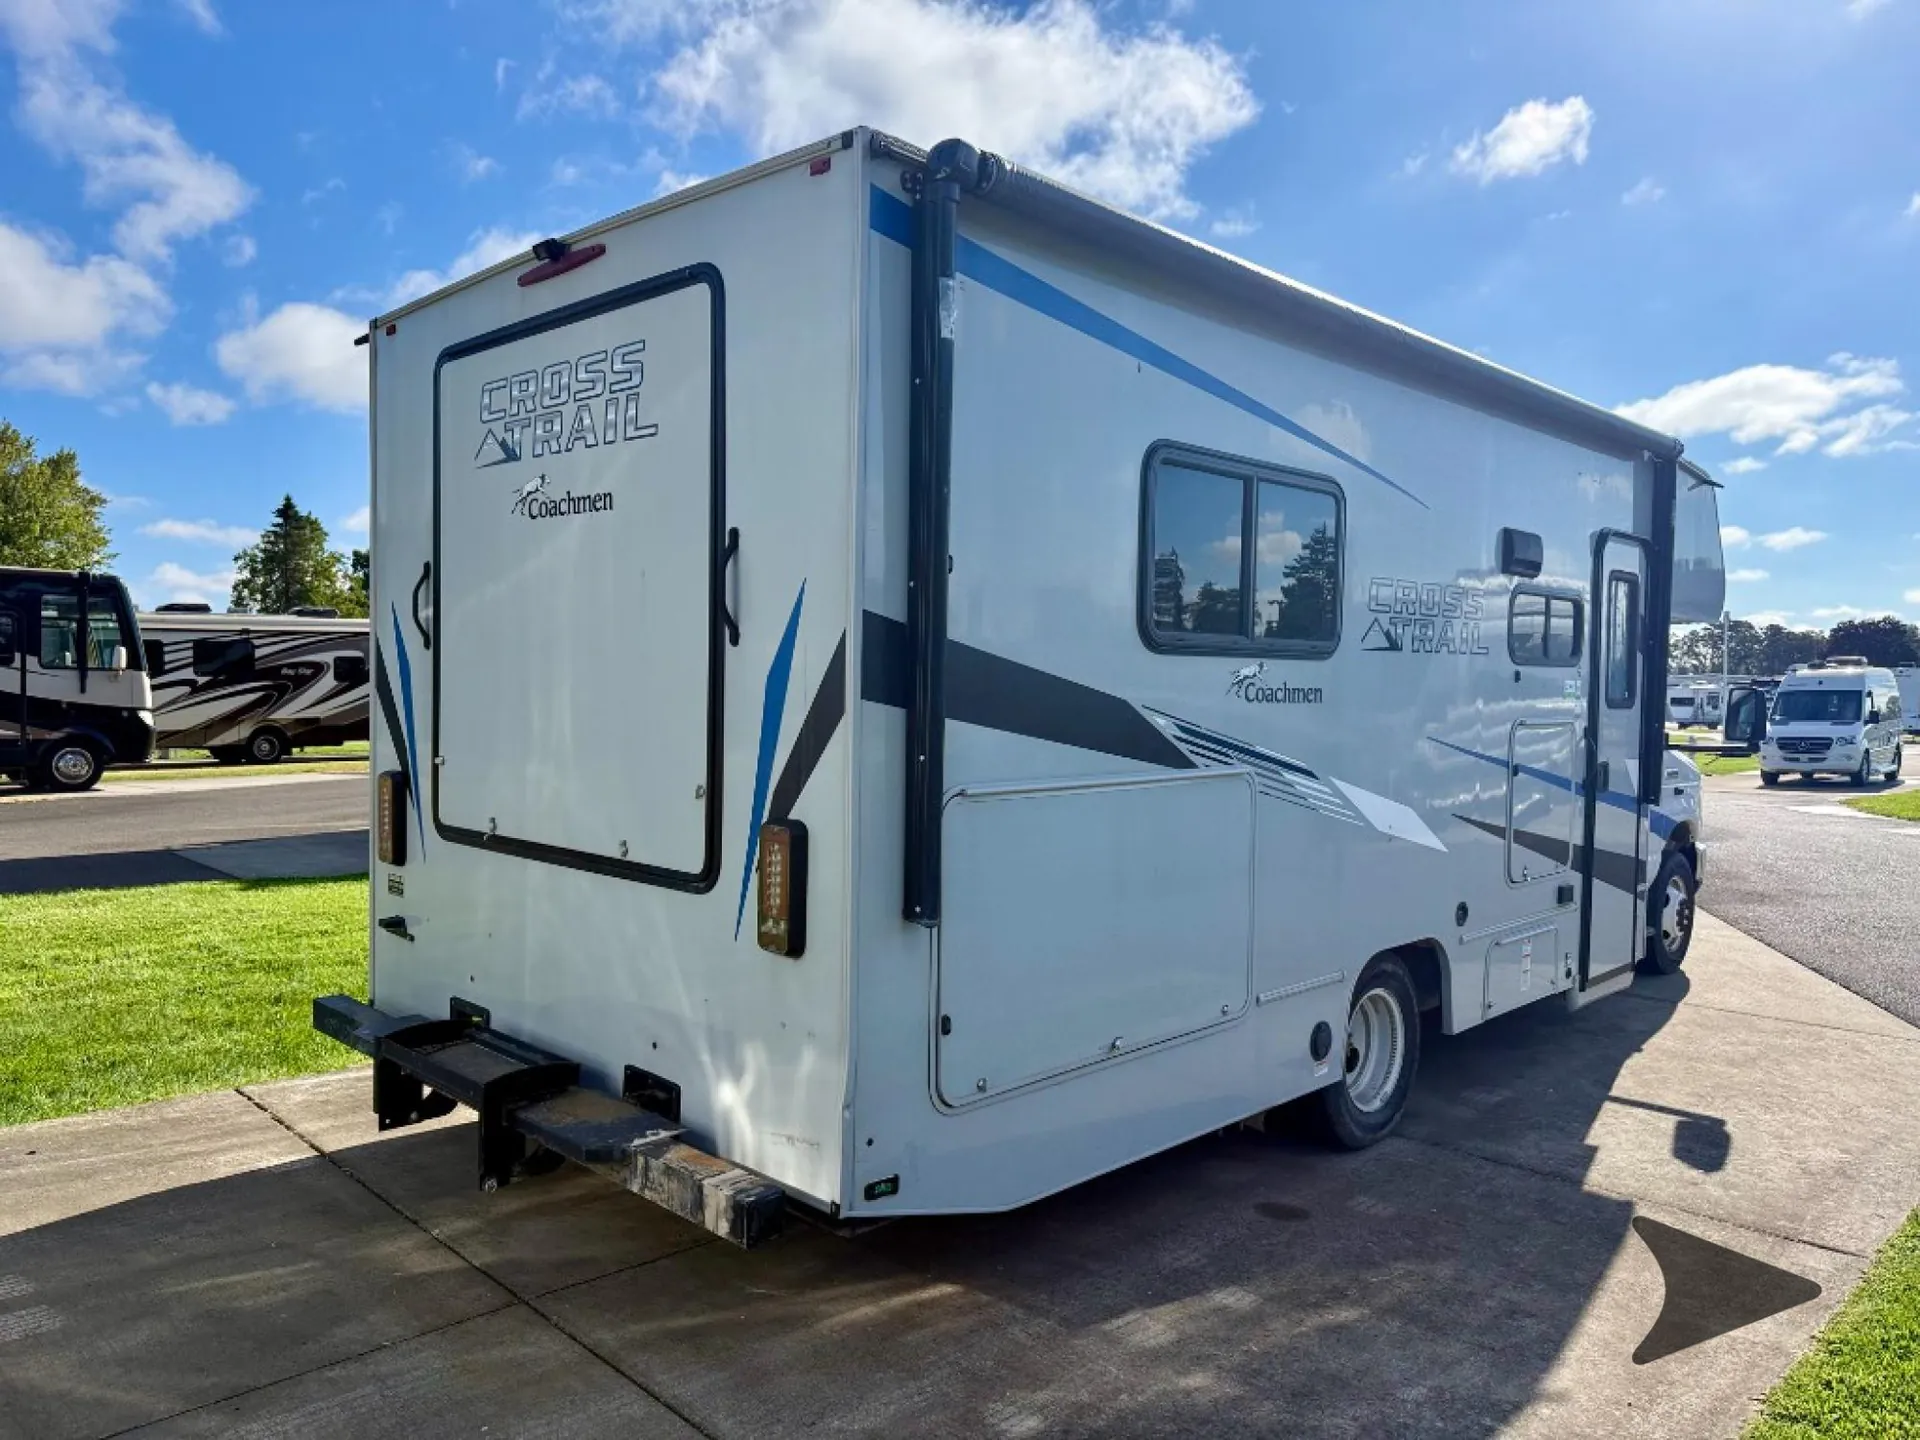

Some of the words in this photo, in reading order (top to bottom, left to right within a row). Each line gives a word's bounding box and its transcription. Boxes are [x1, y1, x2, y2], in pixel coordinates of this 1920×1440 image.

[480, 339, 646, 423] CROSS
[503, 391, 659, 461] TRAIL
[528, 490, 613, 520] Coachmen
[1368, 577, 1484, 620] CROSS
[1389, 616, 1489, 655] TRAIL
[1244, 681, 1323, 704] Coachmen
